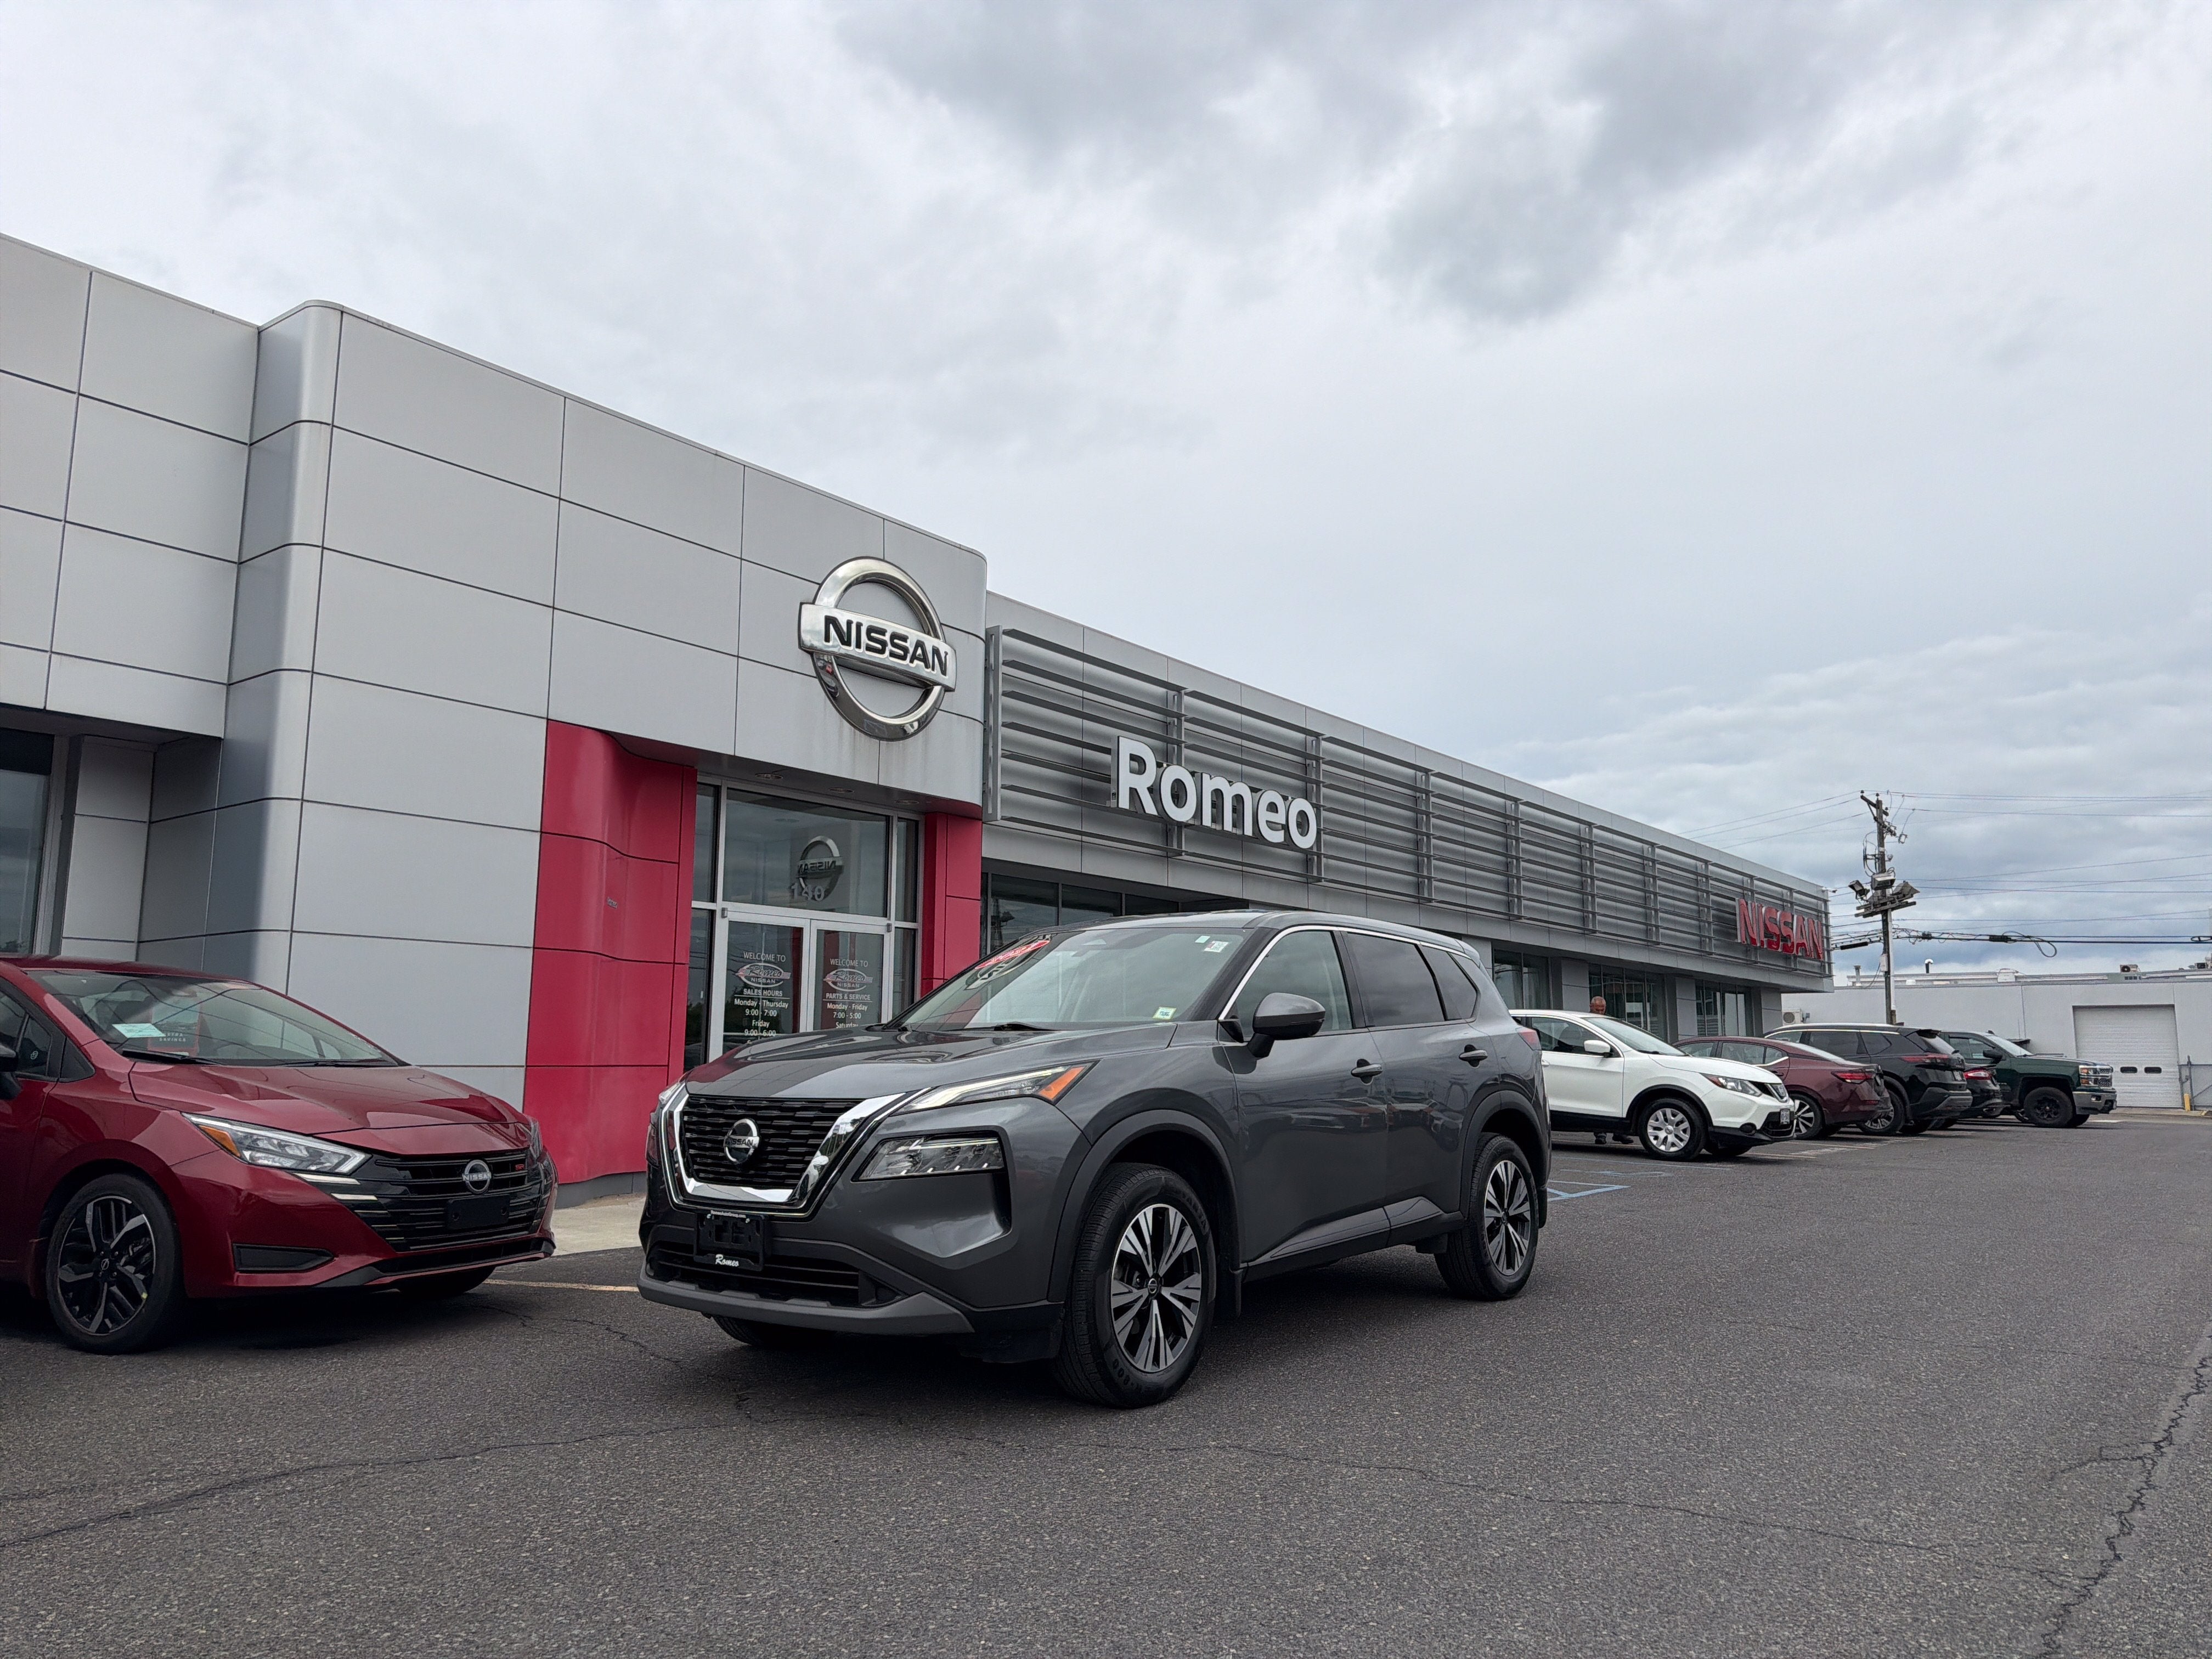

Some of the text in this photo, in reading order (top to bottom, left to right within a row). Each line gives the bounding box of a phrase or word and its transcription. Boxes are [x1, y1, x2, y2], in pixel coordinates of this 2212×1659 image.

[824, 614, 949, 677] NISSAN
[1118, 736, 1317, 849] Romeo
[791, 883, 824, 901] 140
[1738, 898, 1824, 961] NISSAN
[743, 951, 775, 961] WELCOME
[830, 958, 858, 967] WELCOME
[748, 965, 782, 978] Romeo
[835, 970, 865, 981] Romeo
[734, 998, 758, 1007] Monday
[763, 1000, 789, 1009] Thursday
[752, 1020, 770, 1028] Friday
[725, 1138, 754, 1146] NISSAN
[462, 1172, 492, 1181] NISSAN
[715, 1254, 740, 1267] Romeo
